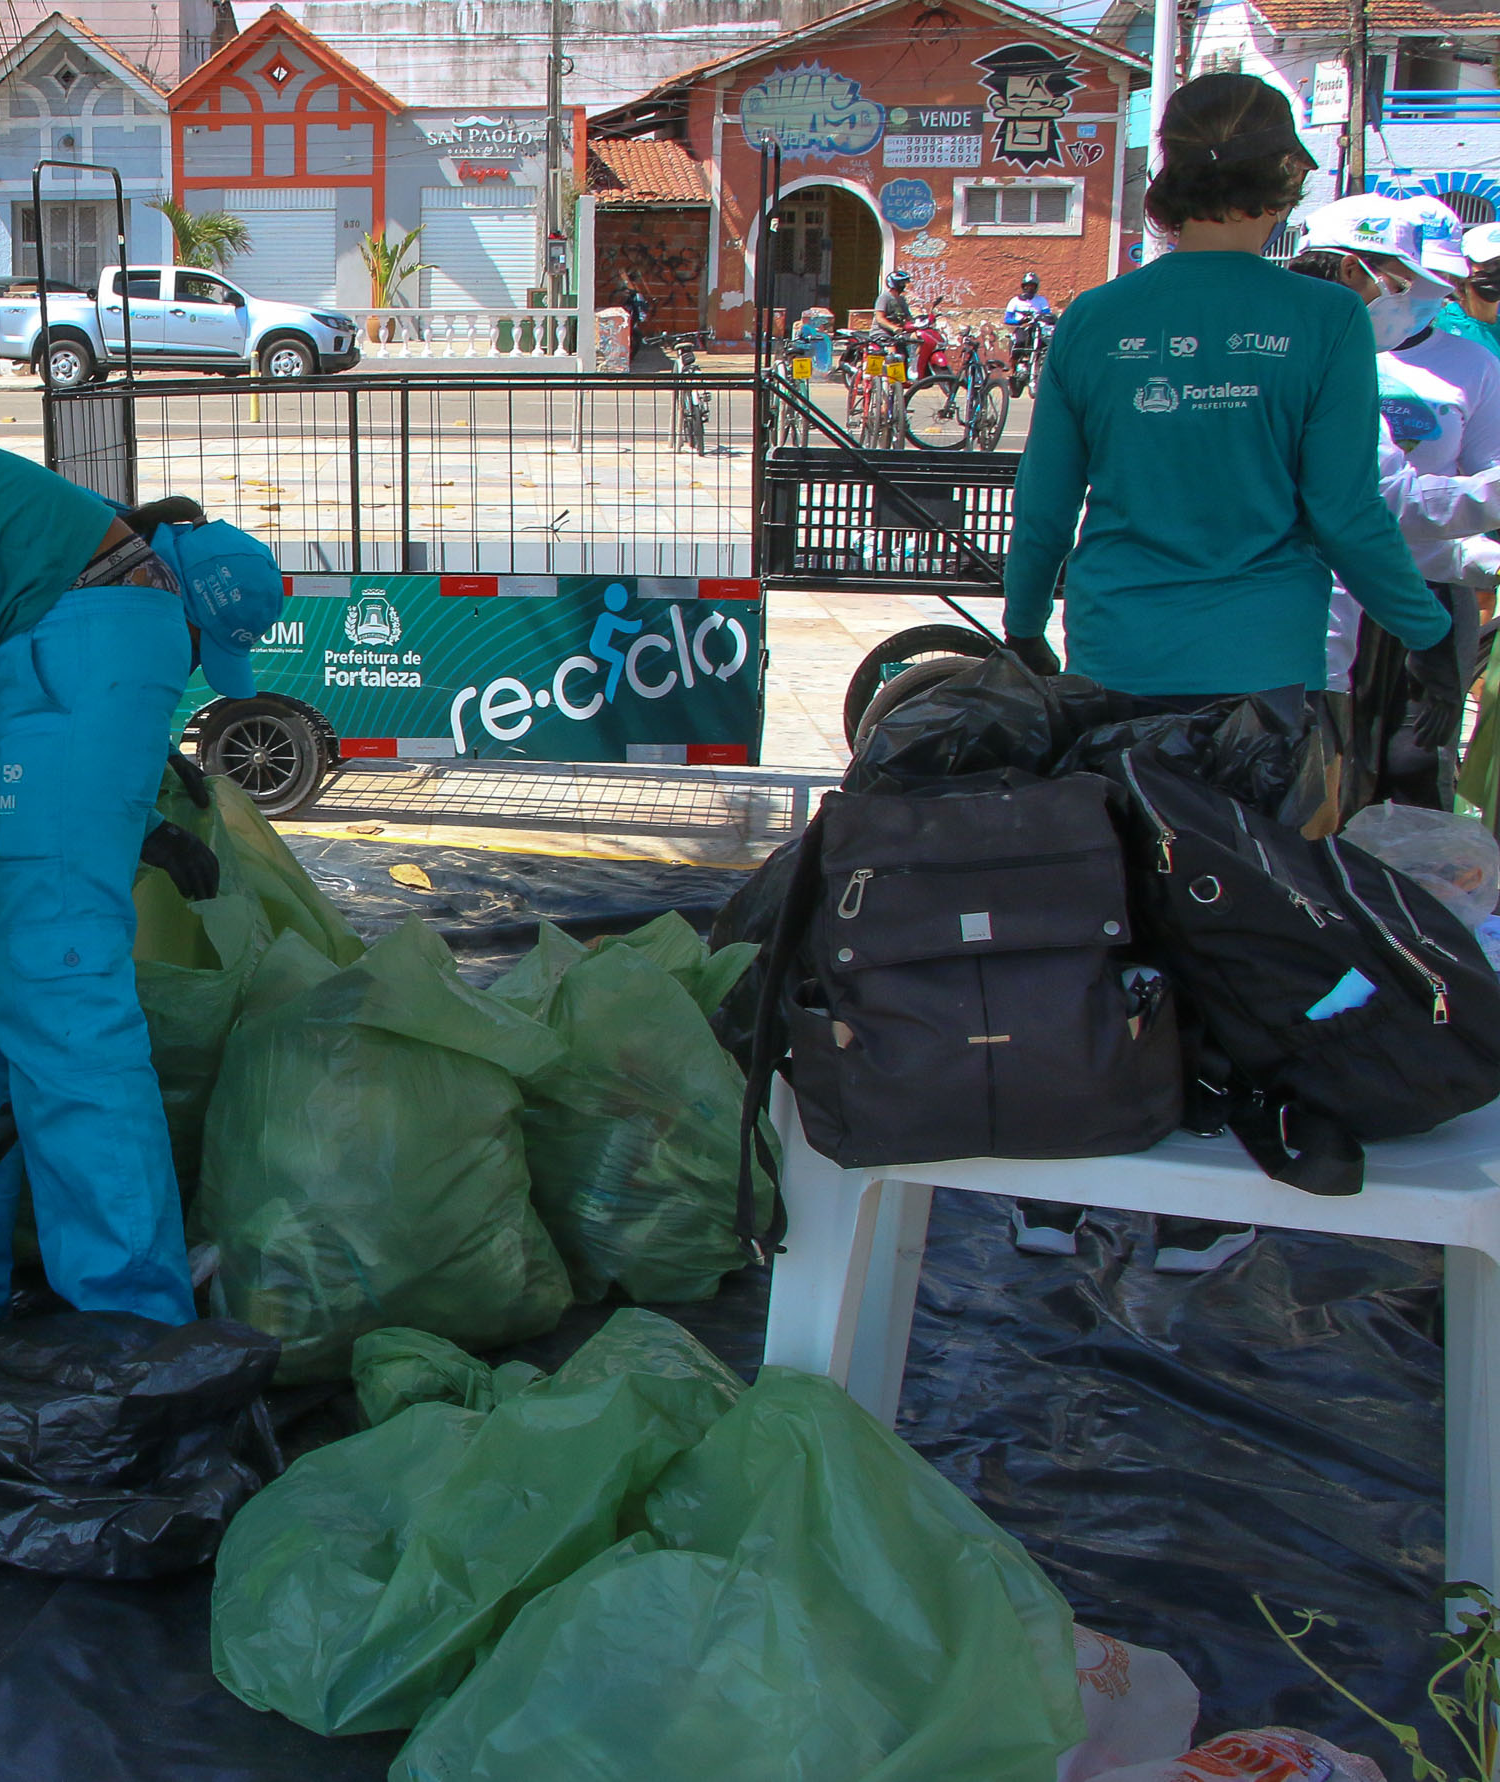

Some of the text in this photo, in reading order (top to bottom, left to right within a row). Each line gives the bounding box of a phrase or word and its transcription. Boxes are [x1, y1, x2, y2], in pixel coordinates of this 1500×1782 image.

[919, 111, 973, 127] VENDE
[428, 129, 462, 146] SAN
[468, 129, 532, 145] PAOLO
[1354, 233, 1385, 244] SEMACE
[1243, 333, 1290, 352] TUMI
[1182, 382, 1259, 401] Fortaleza
[1191, 401, 1248, 411] PREFEITURA
[260, 621, 303, 645] UMI
[324, 650, 421, 665] Prefeitura de
[324, 666, 421, 688] Fortaleza
